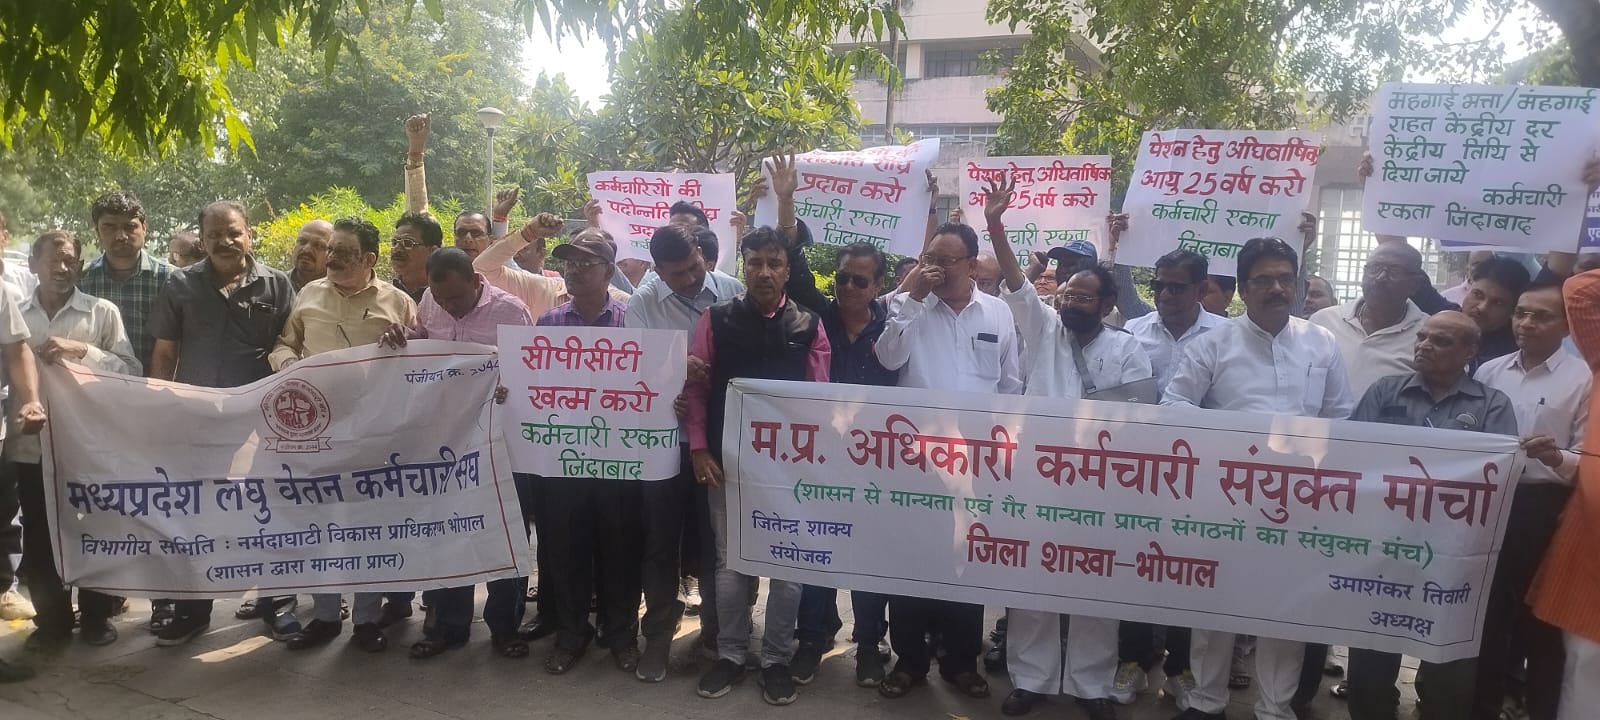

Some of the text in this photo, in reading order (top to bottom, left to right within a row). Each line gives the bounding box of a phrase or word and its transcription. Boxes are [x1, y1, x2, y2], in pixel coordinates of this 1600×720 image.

[1388, 115, 1437, 133] राहत
[1526, 119, 1562, 139] दर
[1520, 138, 1541, 162] से
[1141, 165, 1306, 197] आयु 25 वर्ष करो
[1381, 160, 1424, 183] दिया
[678, 179, 702, 197] की
[860, 176, 906, 204] करो
[1062, 186, 1098, 209] करो
[1482, 182, 1568, 208] कर्मचारी
[794, 197, 845, 221] र्मचारी
[1152, 198, 1219, 224] कर्मचारी
[1445, 202, 1536, 235] जिंदाबाद
[1178, 230, 1245, 259] जिंदाबा
[521, 335, 643, 373] सीपीसीटी
[528, 381, 659, 413] खत्म करो
[521, 414, 611, 448] कर्मचारी
[558, 449, 644, 479] जिंदाबाद
[750, 413, 1499, 528] म.प्र. अधिकारी कर्मचारी संयुक्त मोर्चा
[67, 467, 203, 518] मध्यप्रदेश
[213, 477, 271, 524] लघु
[274, 463, 345, 505] वेतन
[352, 446, 457, 499] कर्मचारी
[81, 534, 152, 555] विभागीय
[160, 535, 215, 556] समिति
[237, 523, 321, 550] नर्मदाघाटी
[328, 522, 382, 544] विकास
[388, 518, 446, 540] प्राधिकरण
[447, 512, 485, 534] भोपाल
[752, 510, 853, 538] जितेन्द्र शाक्य
[793, 478, 1435, 569] (शासन से मान्यता एवं गैर मान्यता प्राप्त संगठनों का संयुक्त मंच)
[769, 542, 833, 566] संयोजक
[966, 522, 1030, 568] जिला
[206, 552, 405, 582] (शासन द्वारा मान्यता प्राप्त)
[1328, 574, 1472, 606] उमाशंकर तिवारी
[1368, 610, 1435, 636] अध्यक्ष
